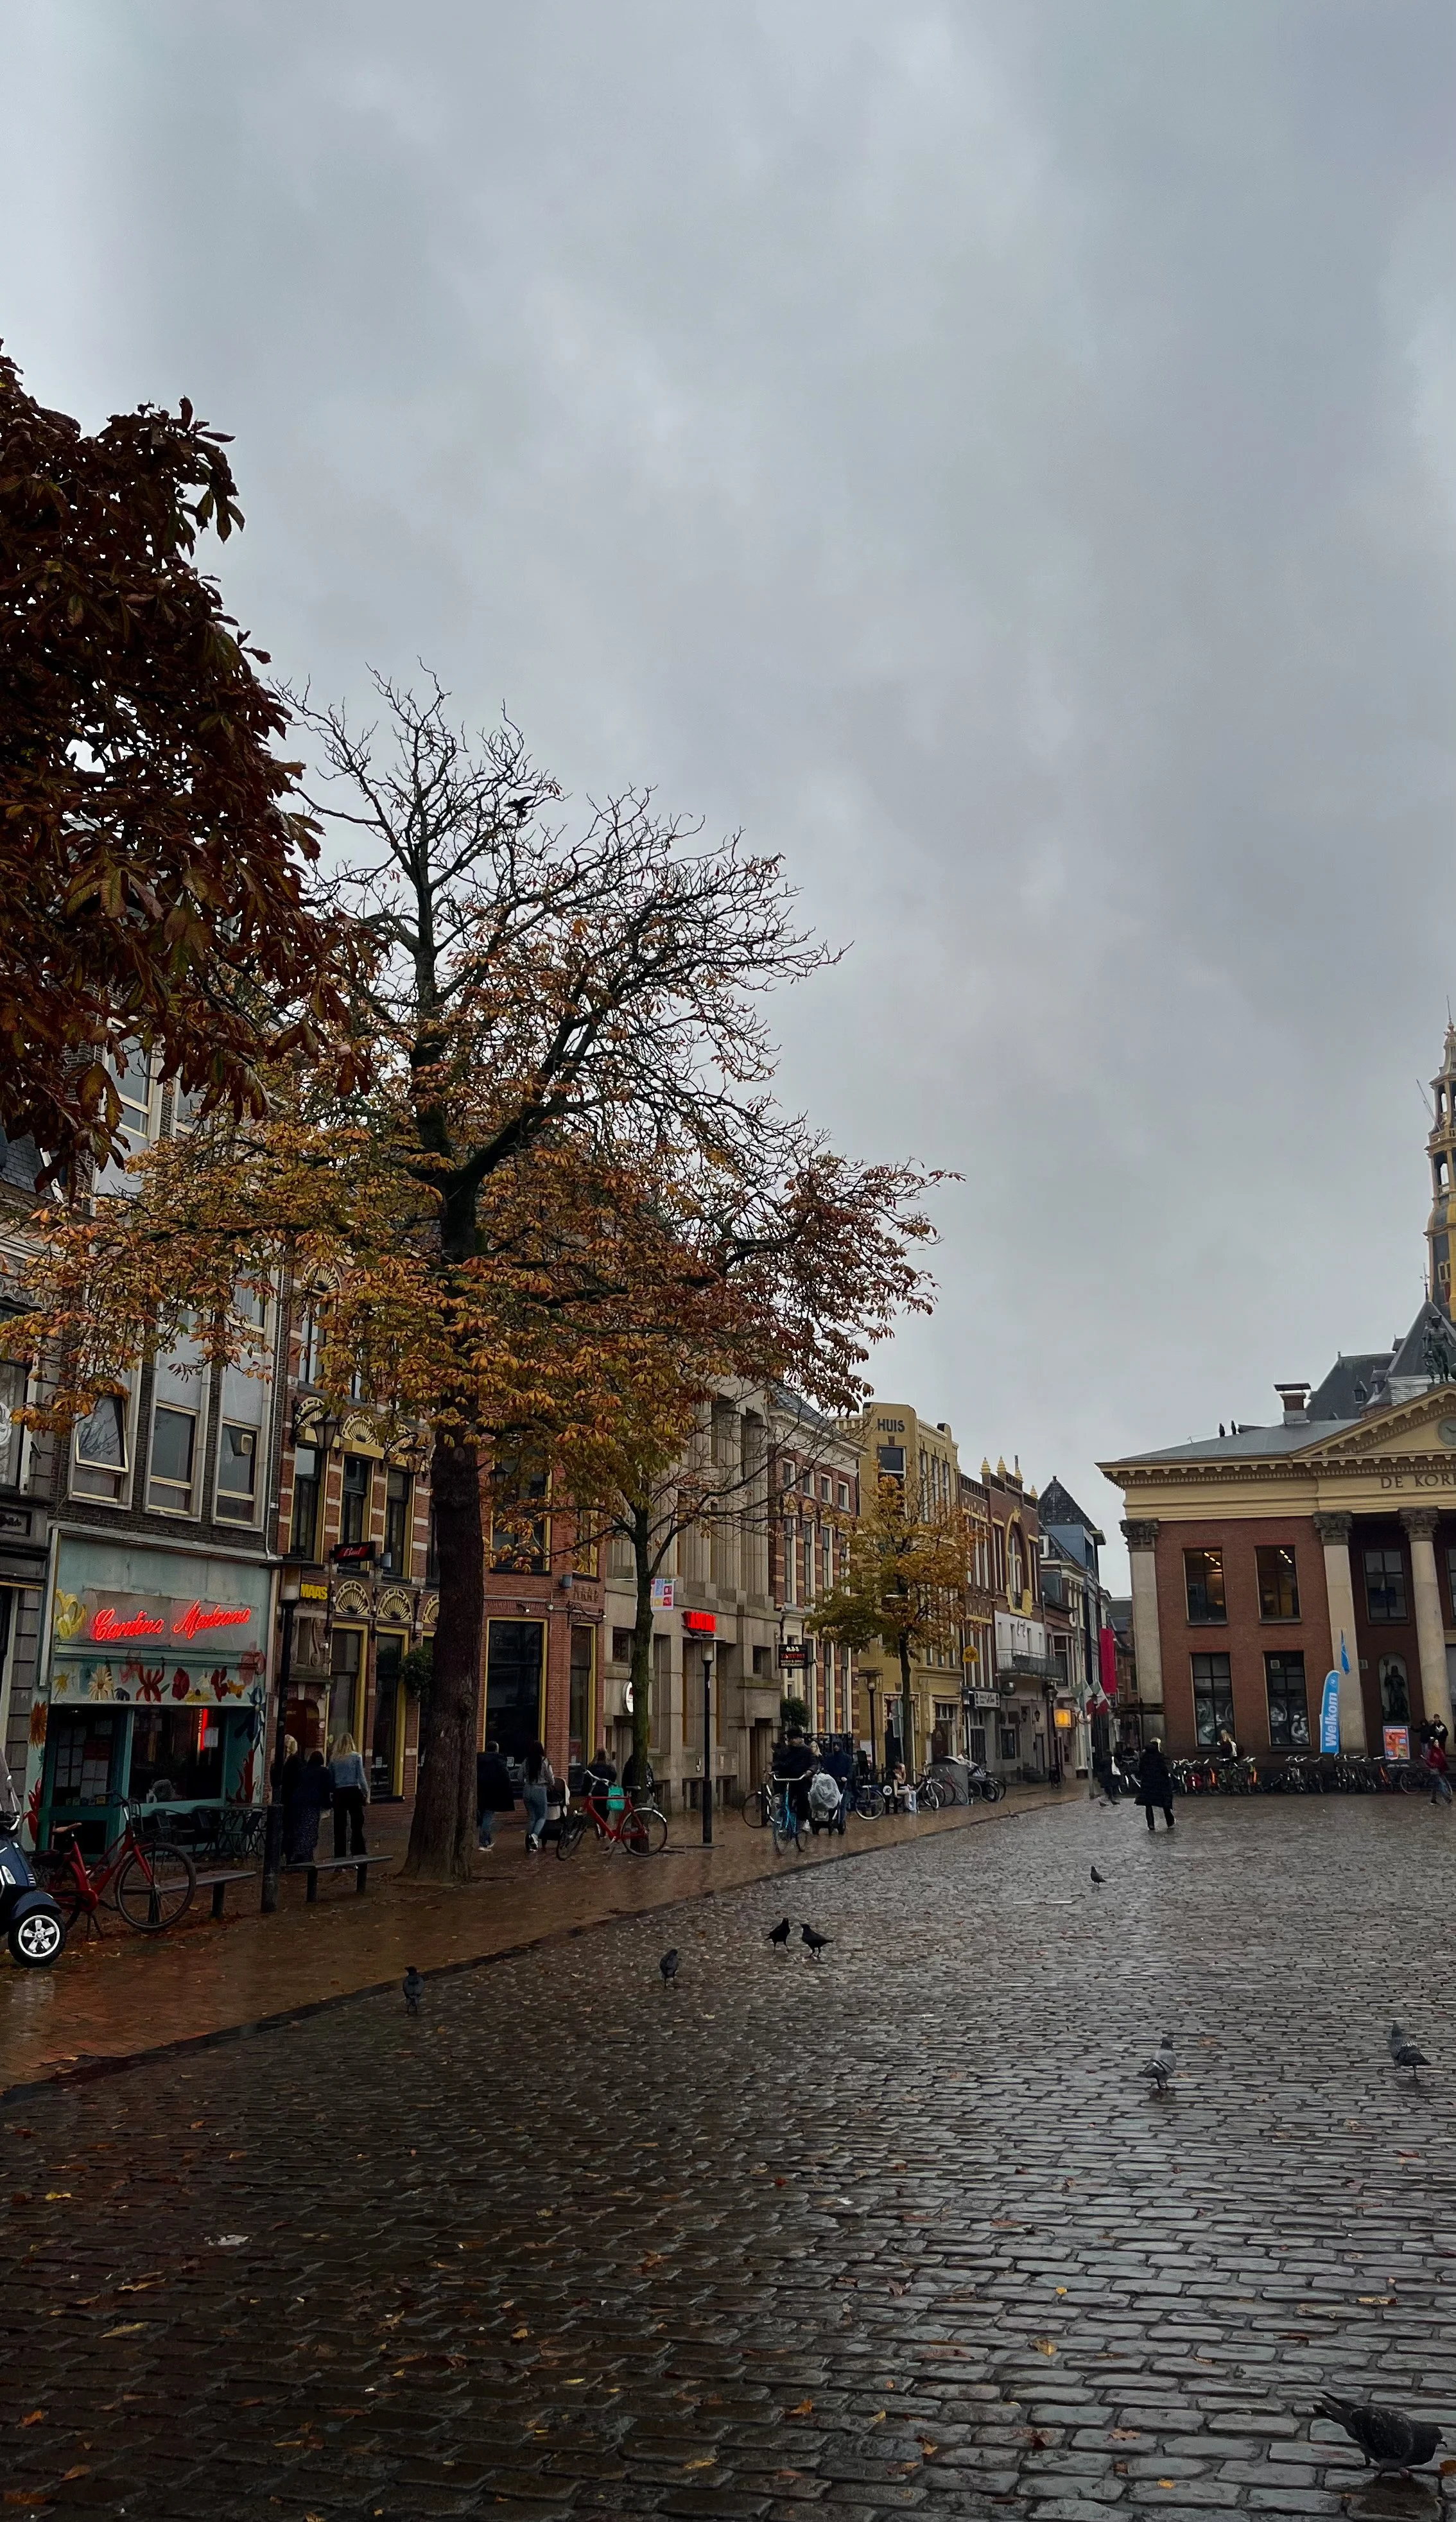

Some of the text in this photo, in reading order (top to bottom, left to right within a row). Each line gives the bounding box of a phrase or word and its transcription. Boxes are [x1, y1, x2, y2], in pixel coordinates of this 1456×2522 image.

[878, 1418, 905, 1432] HUIS
[1380, 1476, 1403, 1489] DE
[300, 1583, 328, 1600] MAAS
[1324, 1692, 1339, 1747] Welkom
